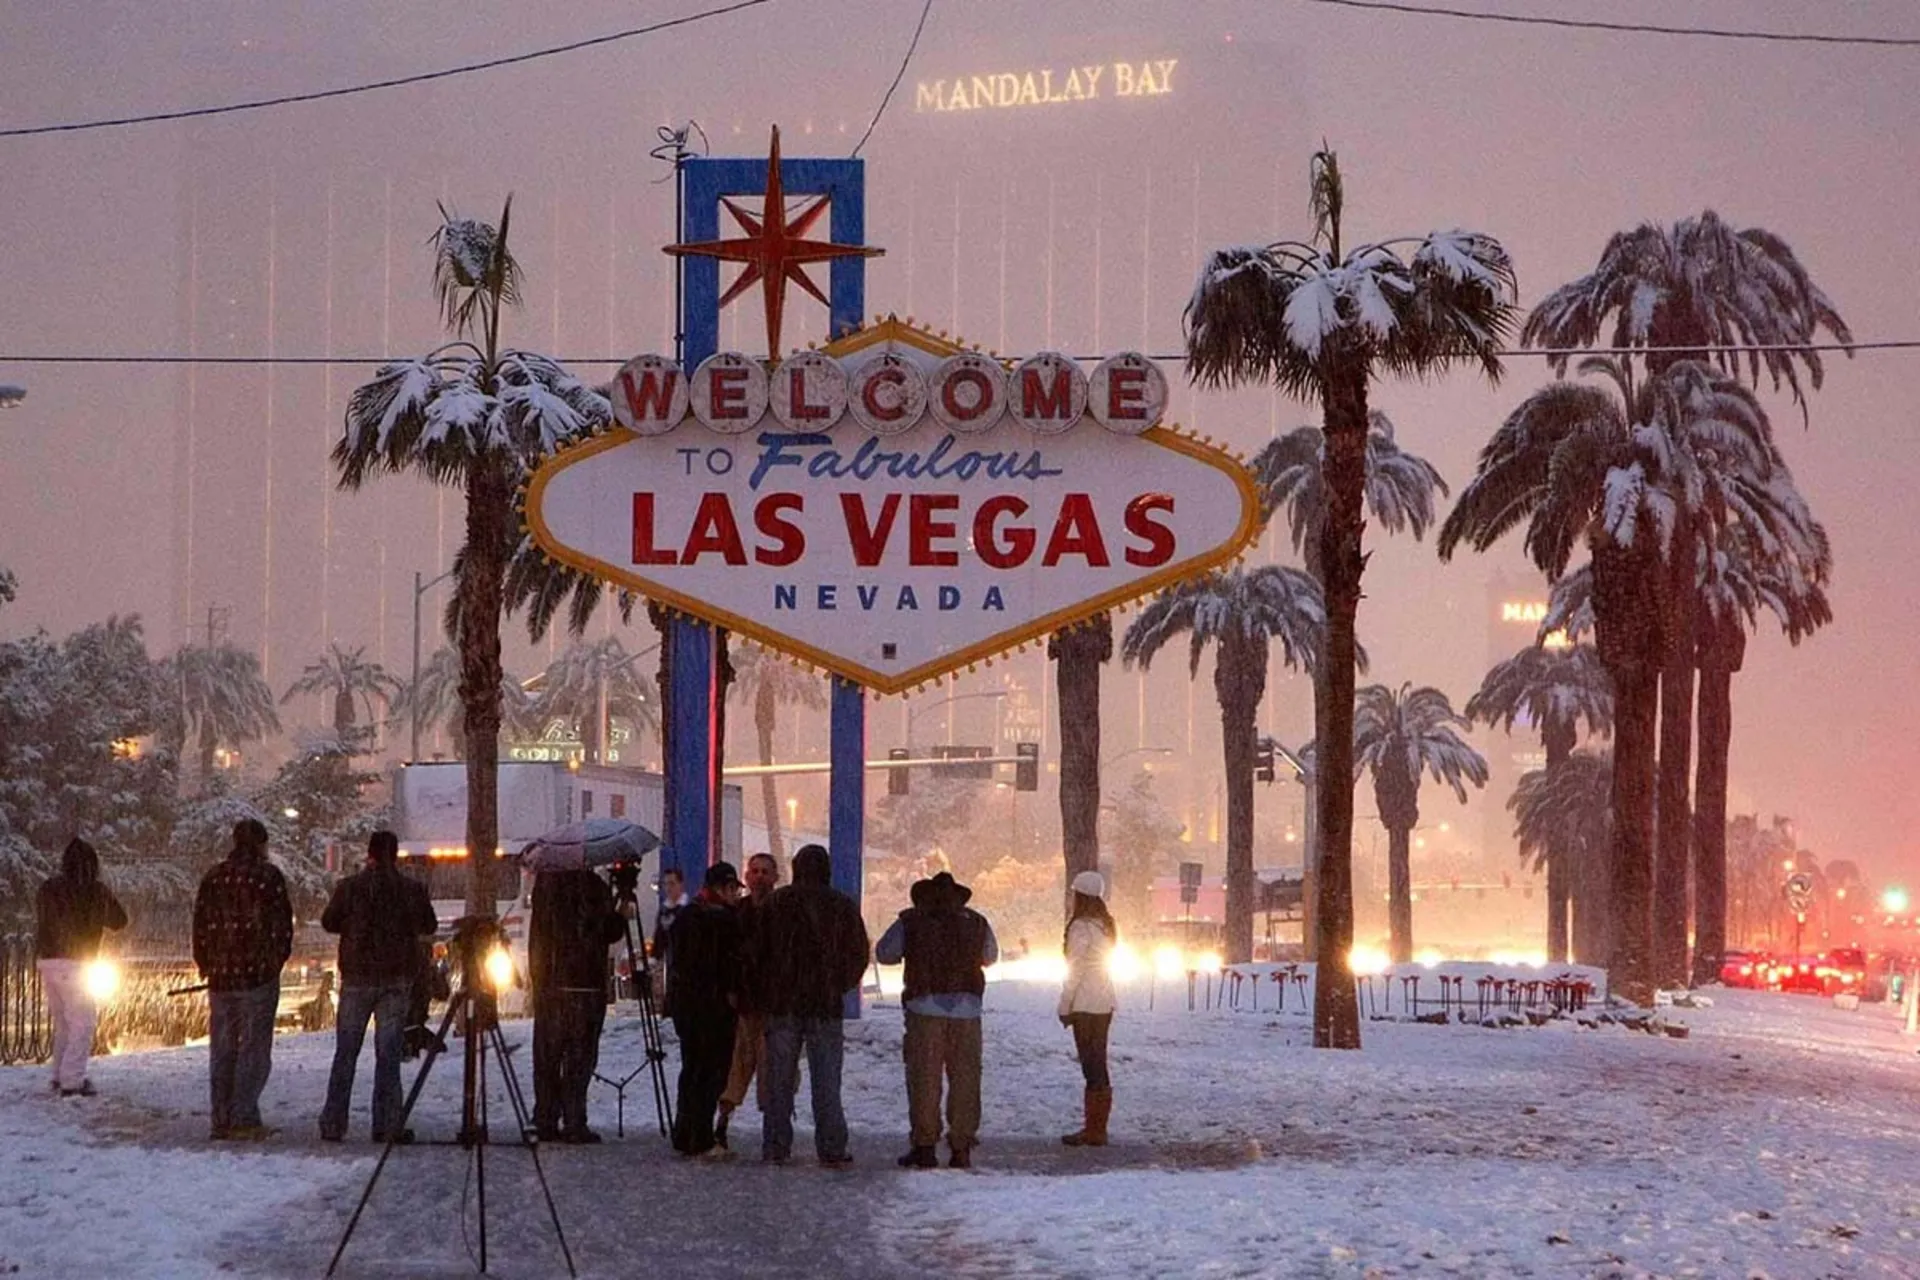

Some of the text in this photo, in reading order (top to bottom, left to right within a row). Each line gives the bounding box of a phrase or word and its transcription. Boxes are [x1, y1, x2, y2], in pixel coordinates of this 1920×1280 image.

[915, 59, 1178, 112] MANDALAY BAY
[620, 366, 1148, 421] WELCOME
[676, 431, 1063, 491] TO Fabulous
[632, 491, 1176, 569] LAS VEGAS
[774, 584, 1005, 611] NEVADA
